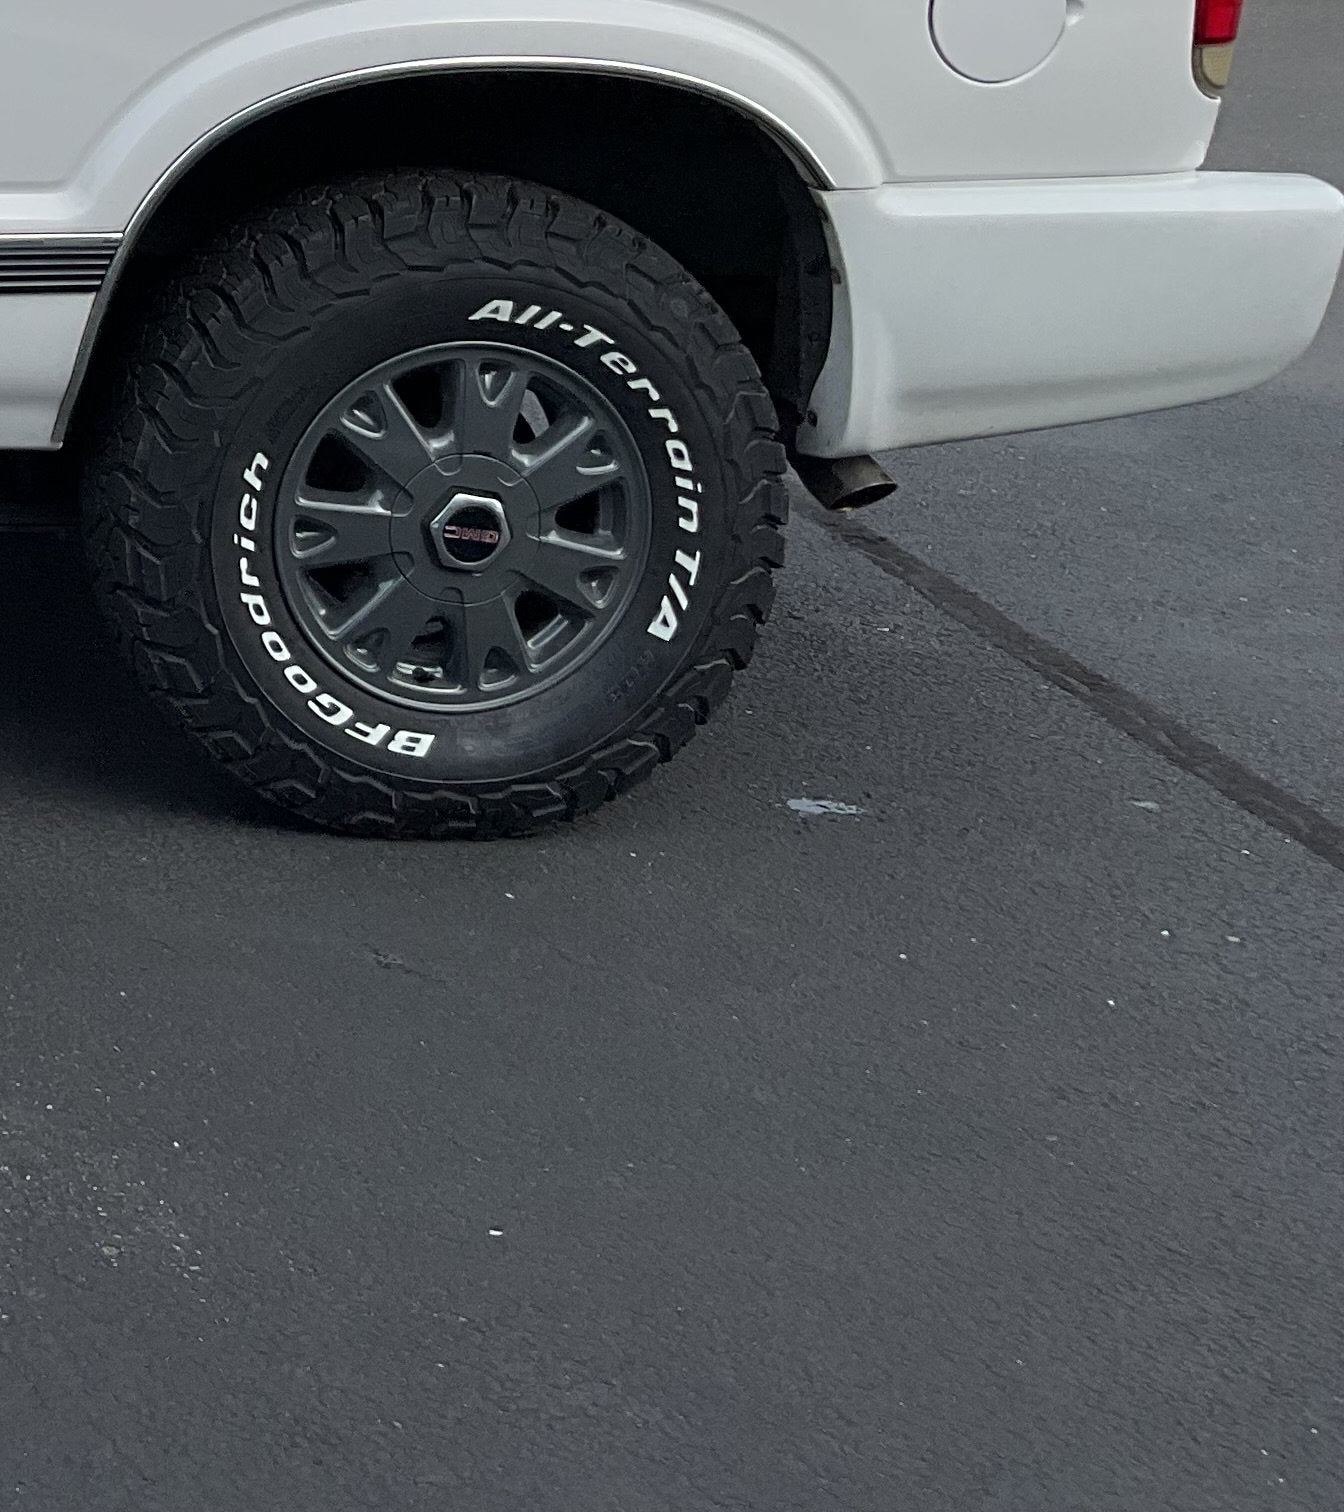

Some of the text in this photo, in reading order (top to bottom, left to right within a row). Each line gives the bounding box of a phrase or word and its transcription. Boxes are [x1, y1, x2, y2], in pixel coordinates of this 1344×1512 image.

[233, 451, 436, 758] BFGoodrich
[443, 524, 500, 544] GMC
[467, 299, 703, 642] All-Terrain T/A
